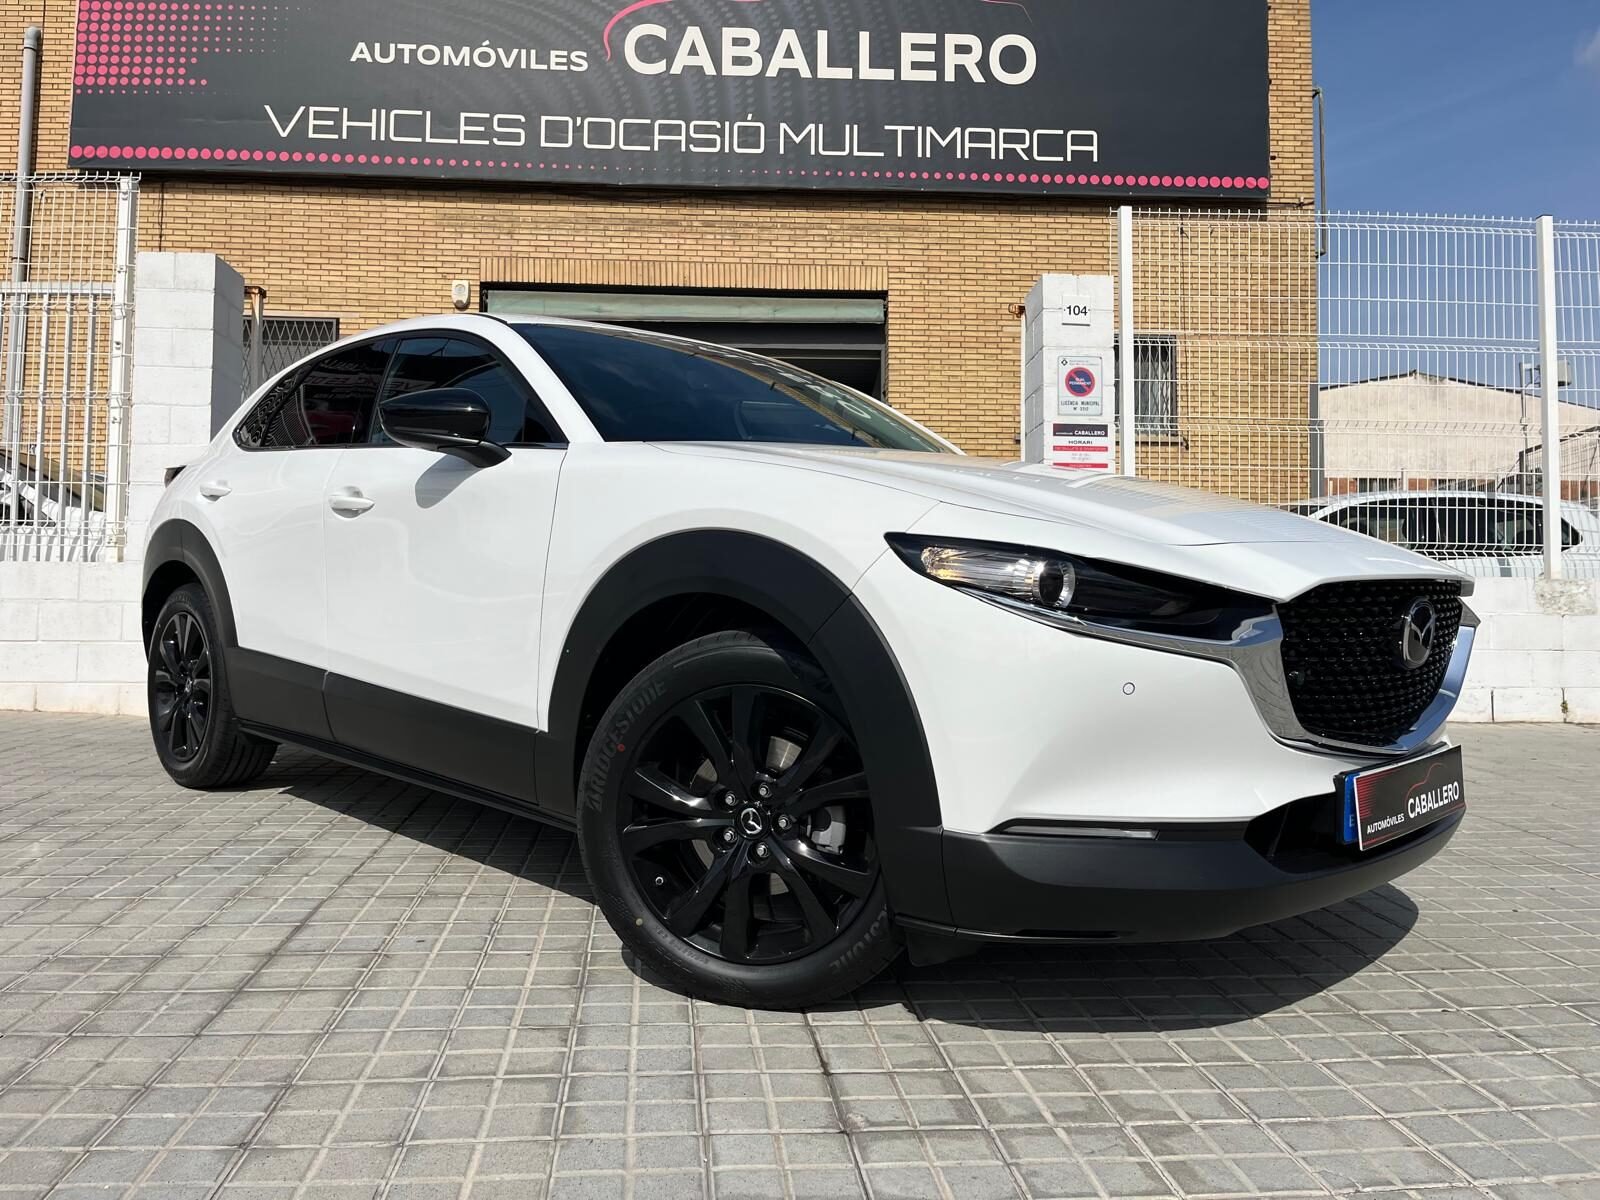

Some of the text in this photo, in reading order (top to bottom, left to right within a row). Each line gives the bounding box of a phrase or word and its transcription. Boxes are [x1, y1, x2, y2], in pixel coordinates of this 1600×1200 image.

[350, 23, 1037, 86] AUTOMÓVILES CABALLERO
[263, 104, 1098, 163] VEHICLES D'OCASIÓ MULTIMARCA
[1066, 305, 1088, 316] 104
[1366, 781, 1460, 835] AUTOMÓVILES CABALLERO
